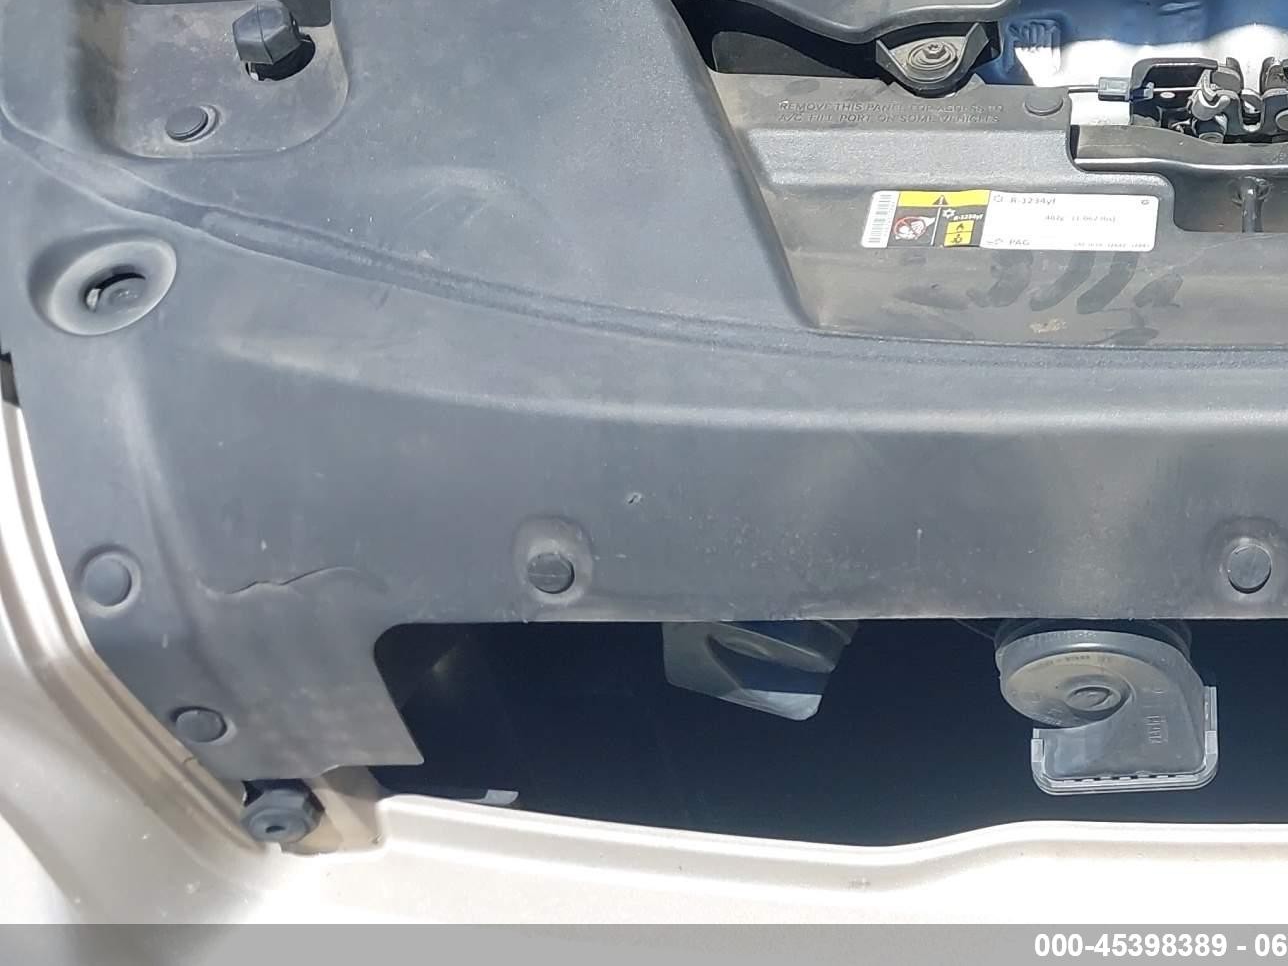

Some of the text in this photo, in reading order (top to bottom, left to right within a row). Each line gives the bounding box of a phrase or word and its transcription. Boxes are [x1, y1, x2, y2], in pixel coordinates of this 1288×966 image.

[779, 101, 830, 112] REMOVE
[834, 103, 863, 112] THIS
[778, 113, 803, 122] A/C
[840, 114, 871, 122] PORT
